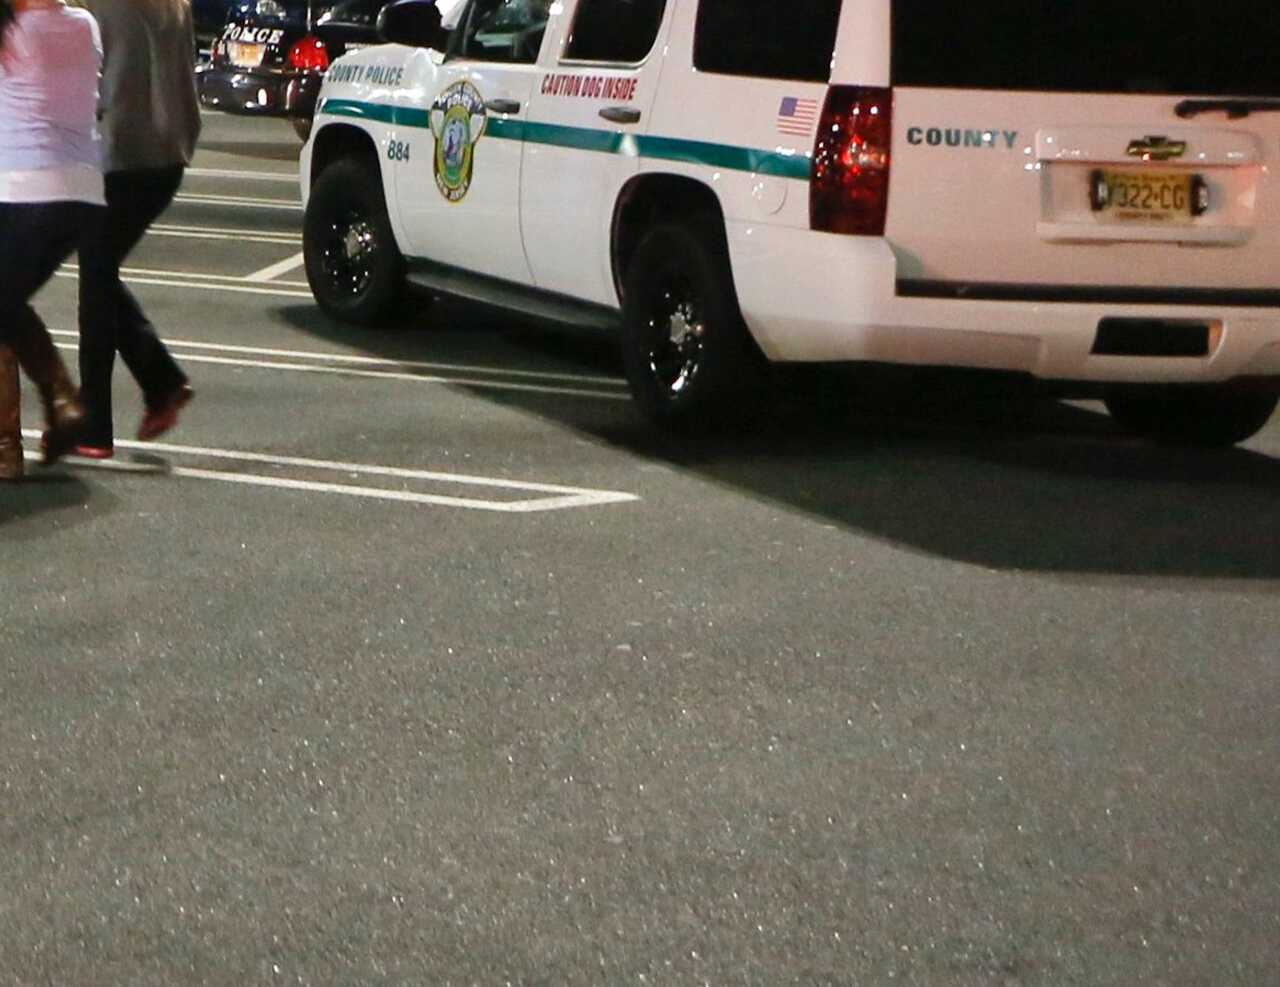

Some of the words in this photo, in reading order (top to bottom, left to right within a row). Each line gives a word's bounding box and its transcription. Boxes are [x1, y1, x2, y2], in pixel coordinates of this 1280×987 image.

[222, 26, 284, 44] POLICE
[365, 65, 404, 86] POLICE
[541, 74, 583, 97] CAUTION
[581, 76, 603, 98] DOG
[602, 77, 638, 101] INSIDE
[906, 126, 1017, 148] COUNTY
[387, 139, 410, 162] 884
